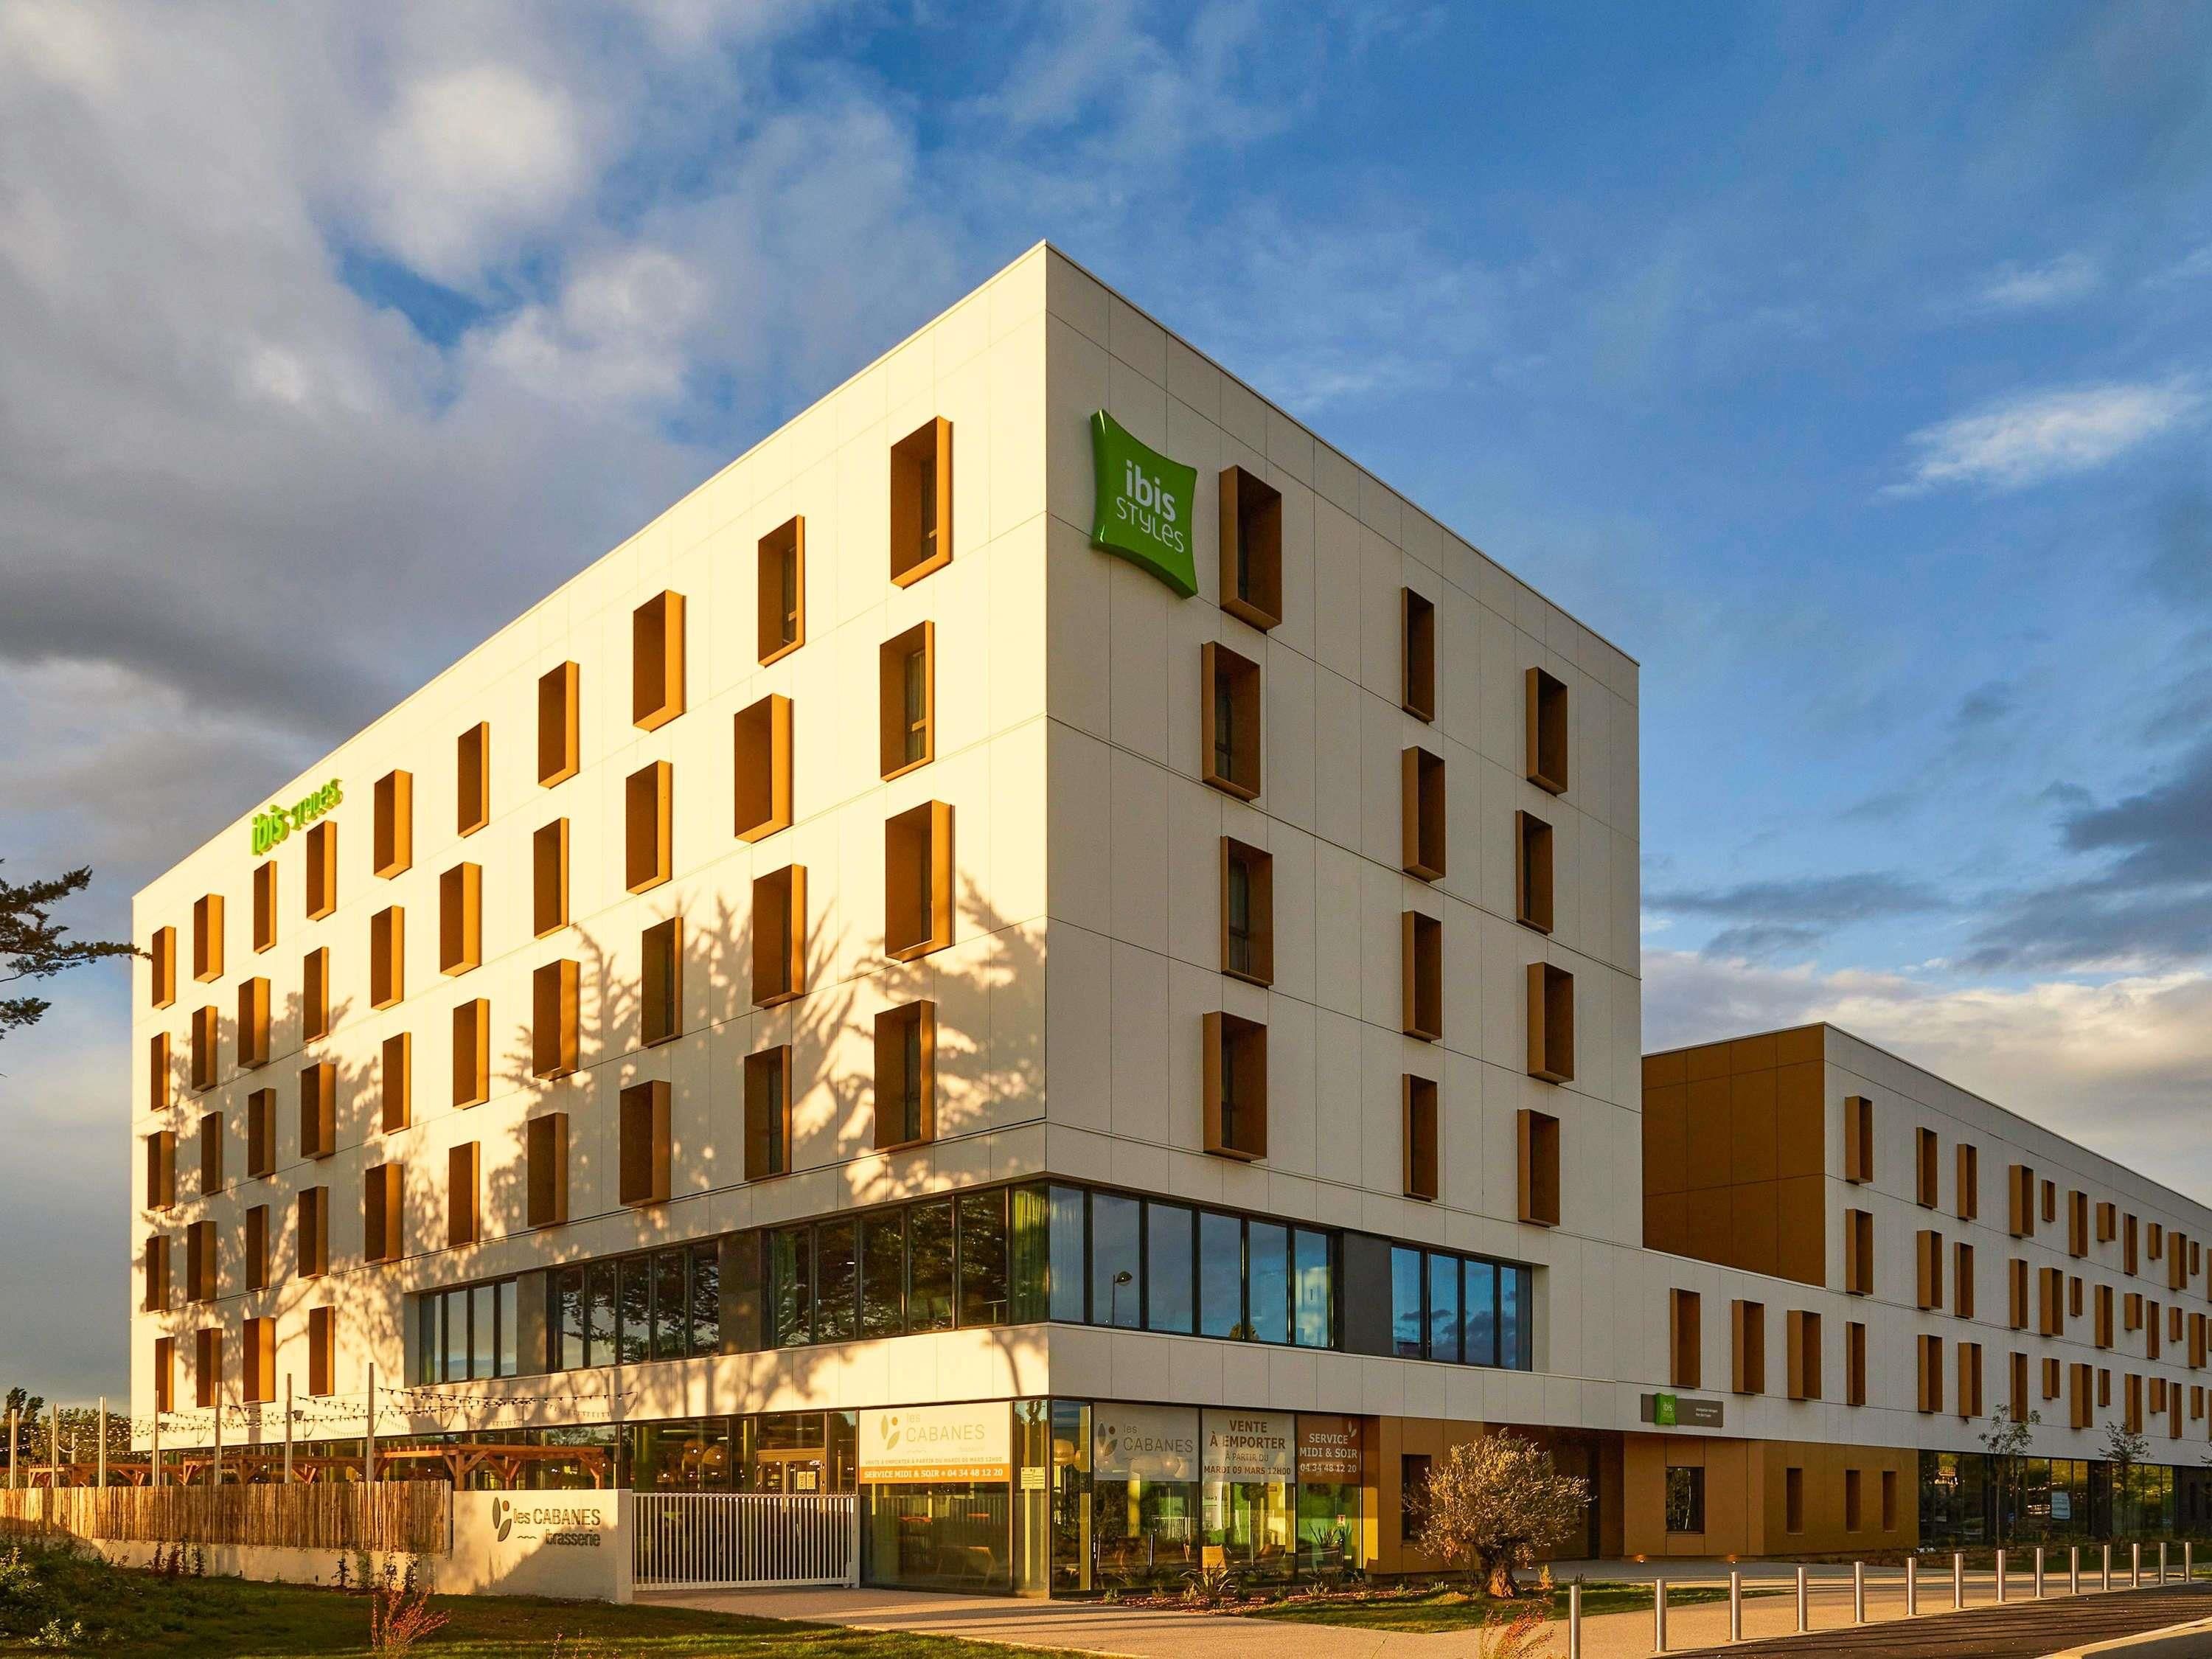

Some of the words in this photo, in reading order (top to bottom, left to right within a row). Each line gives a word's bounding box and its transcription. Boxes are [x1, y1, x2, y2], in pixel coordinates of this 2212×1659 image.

[1126, 459, 1176, 522] ibis
[252, 804, 291, 856] ibis
[907, 1413, 921, 1422] les
[1123, 1424, 1138, 1433] les
[1229, 1419, 1267, 1433] VENTE
[905, 1425, 986, 1443] CABANES
[1209, 1430, 1218, 1447] À
[1222, 1436, 1285, 1450] EMPORTER
[1309, 1433, 1349, 1444] SERVICE
[1123, 1437, 1193, 1453] CABANES
[1232, 1453, 1257, 1462] PARTIR
[1299, 1447, 1323, 1458] MIDI
[1325, 1448, 1332, 1458] &
[1335, 1449, 1357, 1459] SOIR
[864, 1470, 894, 1478] SERVICE
[921, 1469, 939, 1478] SOIR
[947, 1469, 957, 1477] 04
[958, 1469, 968, 1477] 34
[970, 1468, 980, 1477] 48
[981, 1468, 992, 1476] 12
[992, 1468, 1004, 1476] 20
[1204, 1465, 1230, 1474] MARDI
[1233, 1466, 1242, 1475] 09
[1245, 1467, 1265, 1475] MARS
[1268, 1467, 1291, 1475] 12H00
[1300, 1463, 1310, 1472] 04
[1312, 1464, 1322, 1472] 34
[1324, 1464, 1334, 1472] 48
[1335, 1464, 1346, 1473] 12
[1347, 1465, 1357, 1473] 20
[513, 1509, 531, 1524] les
[533, 1509, 601, 1526] CABANES
[546, 1529, 601, 1547] brasserie
